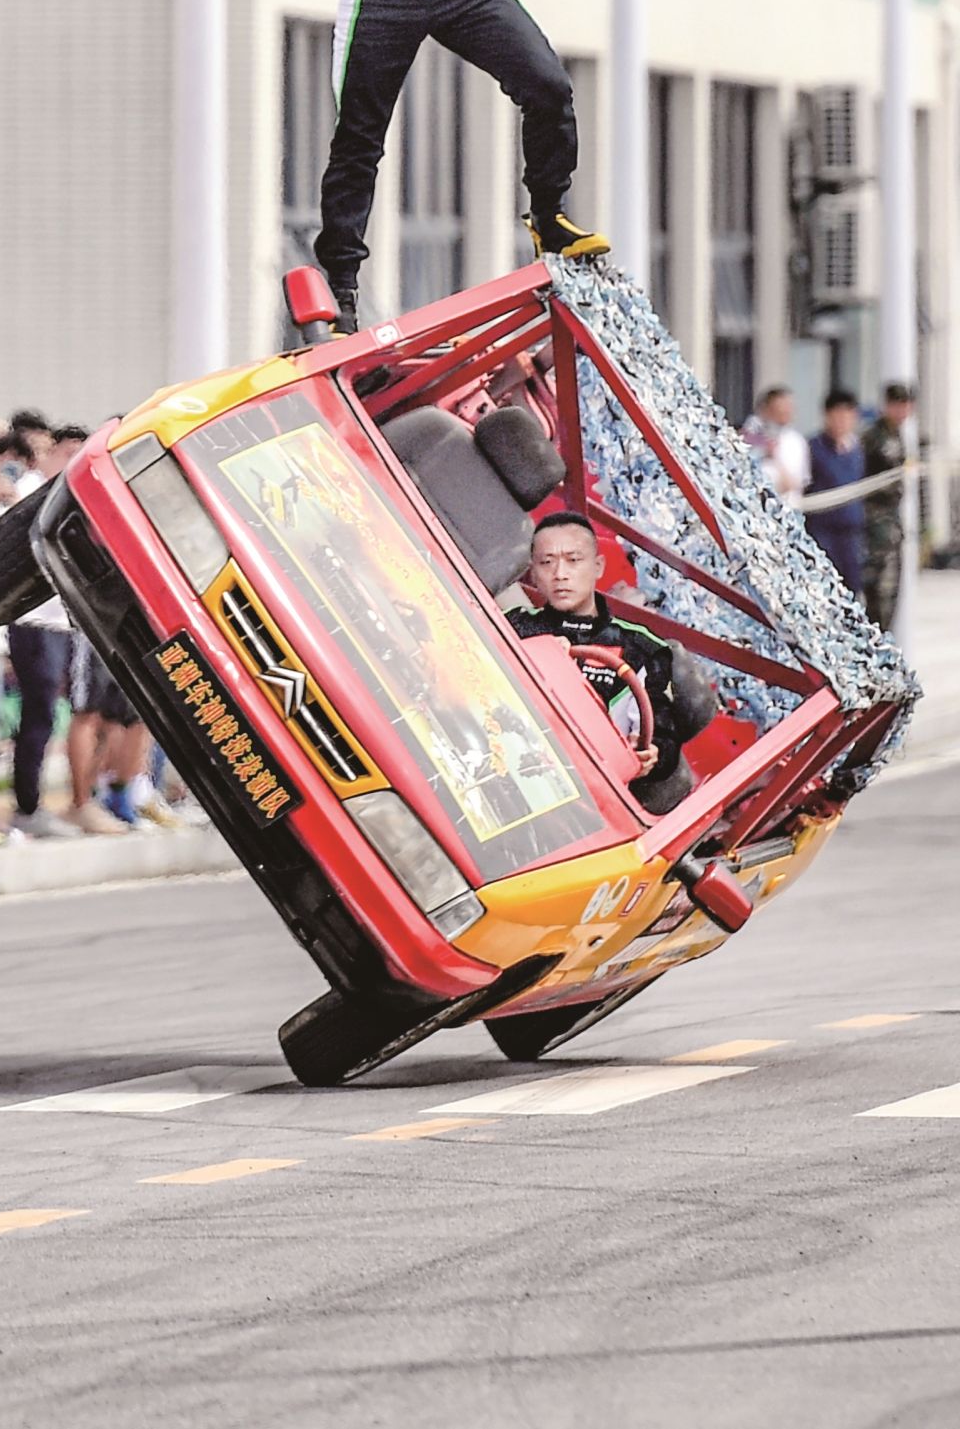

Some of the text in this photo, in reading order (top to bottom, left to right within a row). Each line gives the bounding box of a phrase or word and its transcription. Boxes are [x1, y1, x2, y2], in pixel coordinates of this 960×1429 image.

[156, 642, 291, 819] 亚洲车神特技表演队
